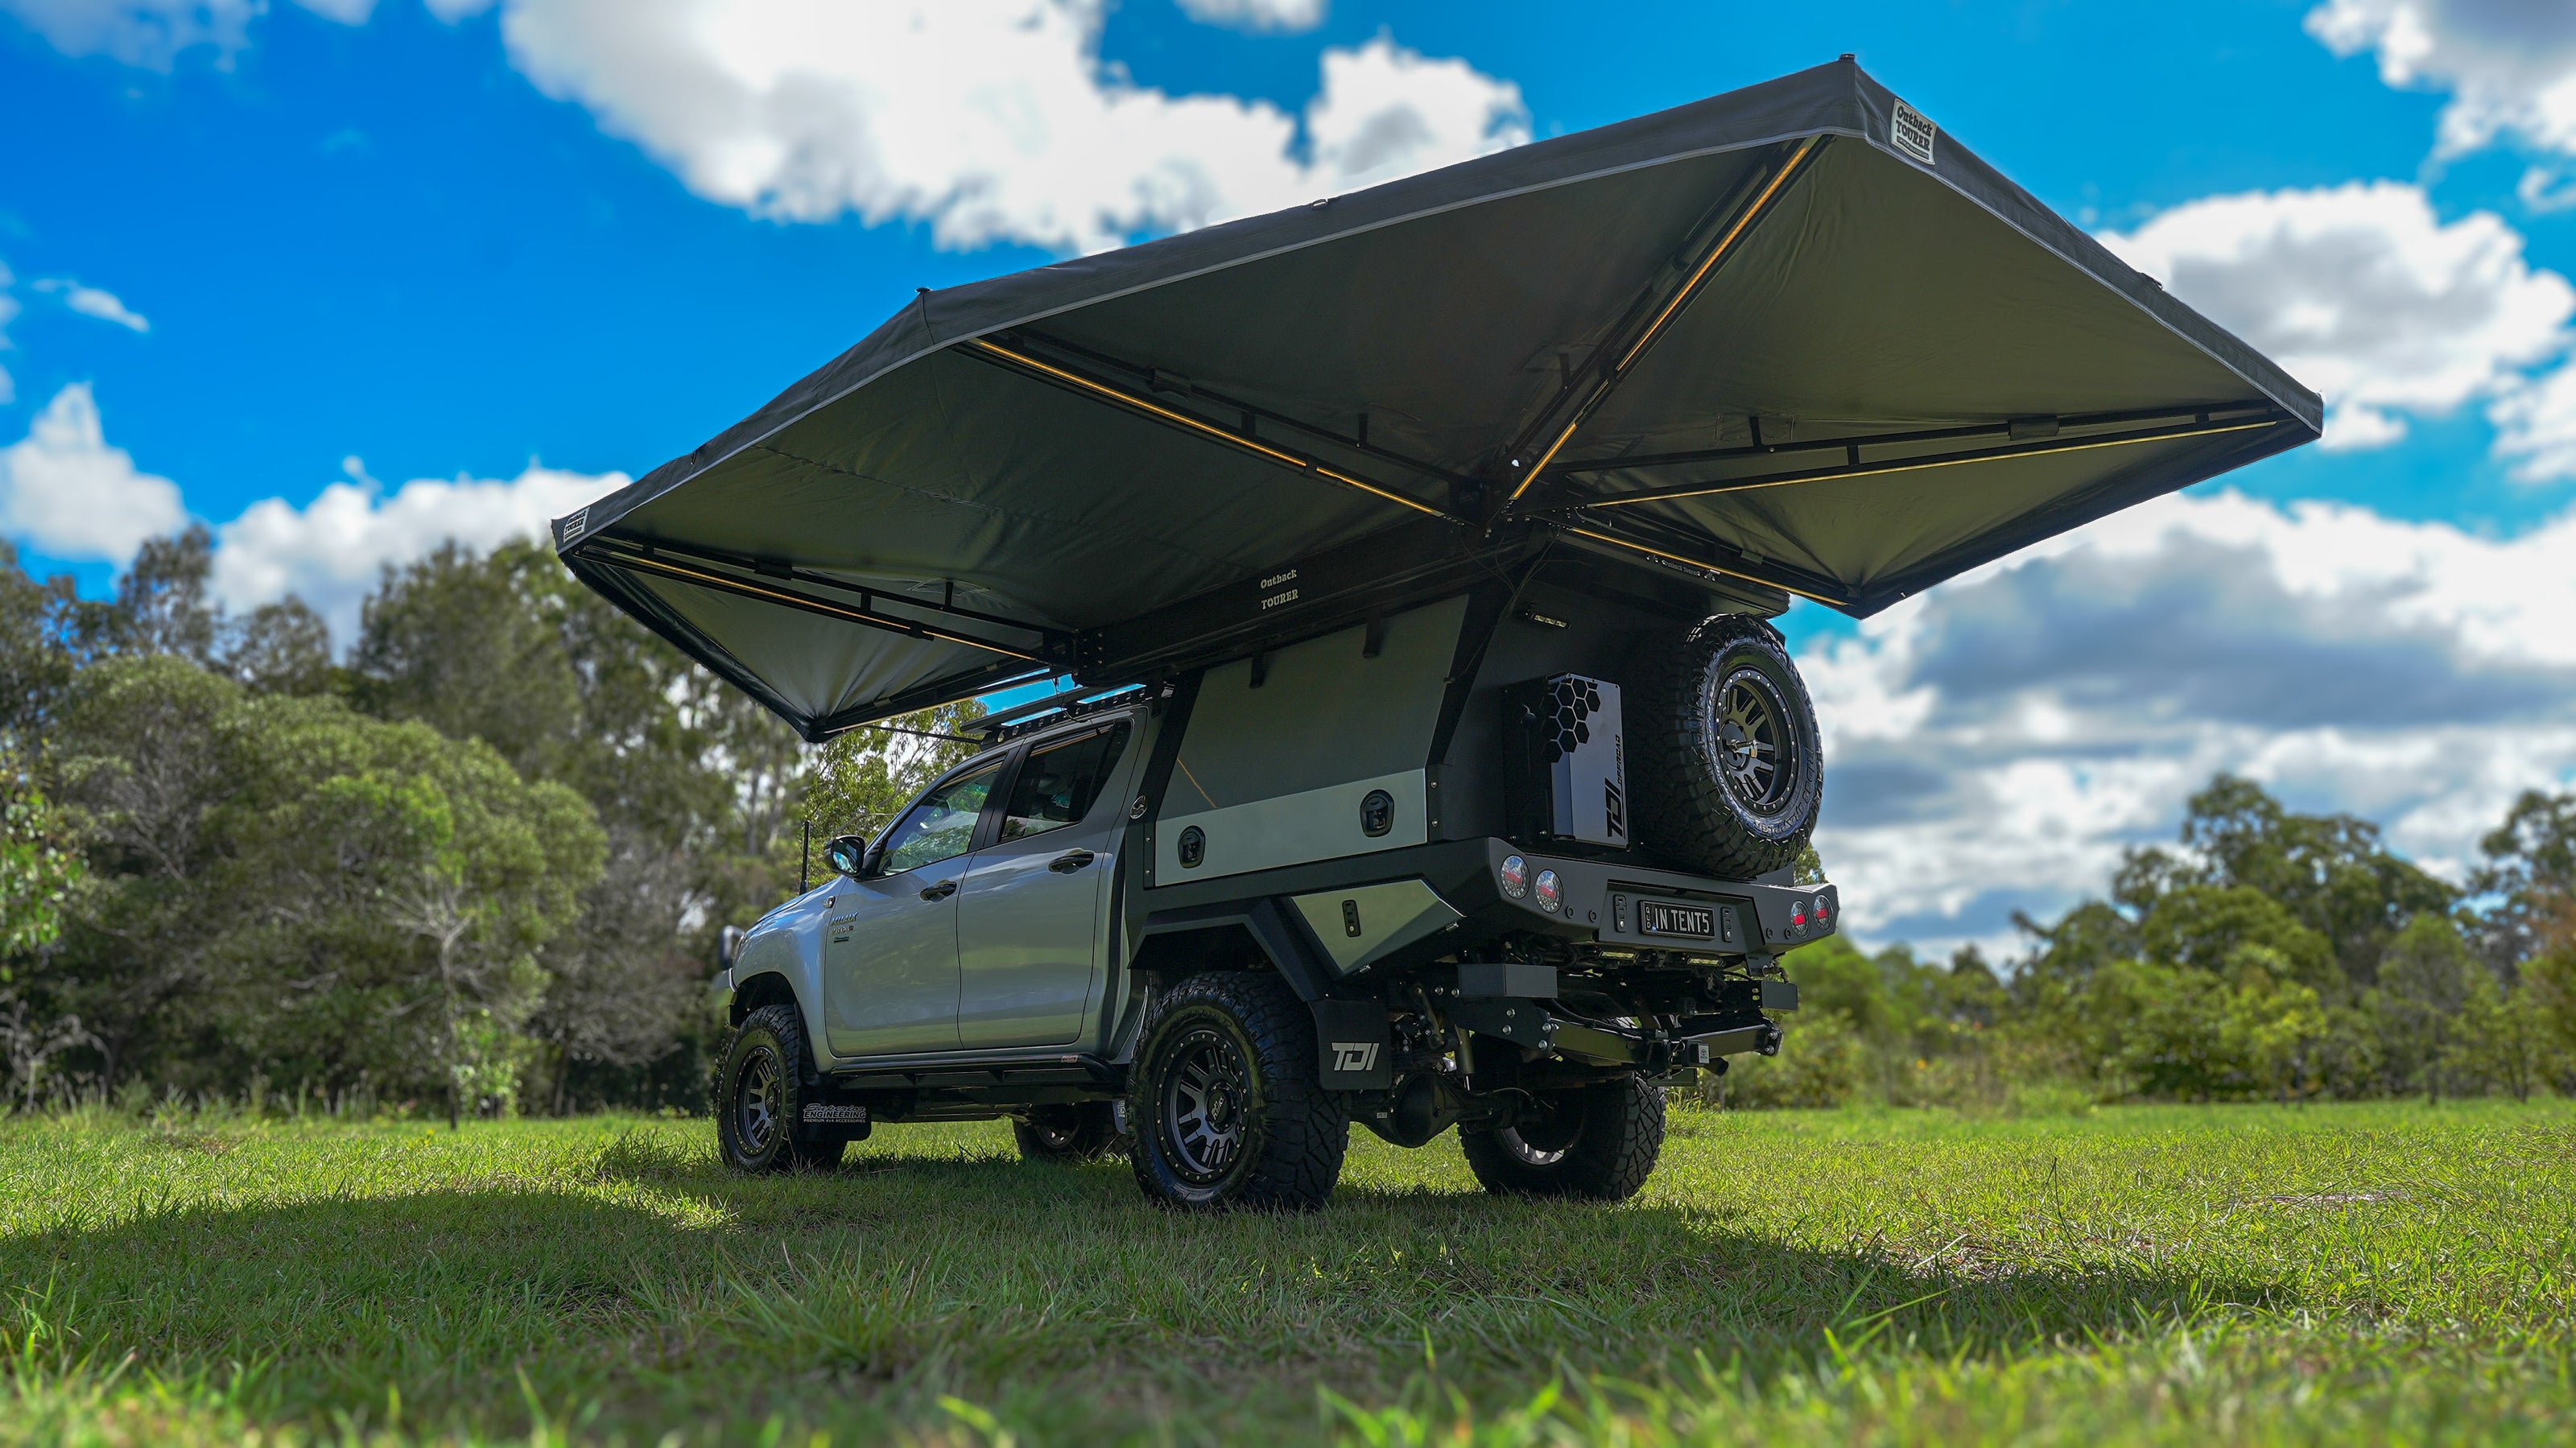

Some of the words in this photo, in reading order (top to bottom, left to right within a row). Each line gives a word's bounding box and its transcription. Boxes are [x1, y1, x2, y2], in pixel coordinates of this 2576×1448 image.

[1896, 119, 1930, 151] TOURER
[1897, 105, 1933, 138] Outback
[1260, 568, 1298, 589] Outback
[1261, 588, 1298, 610] TOURER
[1615, 733, 1623, 785] OFFROAD
[1604, 777, 1624, 838] TDI
[1655, 907, 1669, 930] IN
[1331, 1042, 1380, 1071] TDI
[803, 1111, 867, 1119] ENGINEERING
